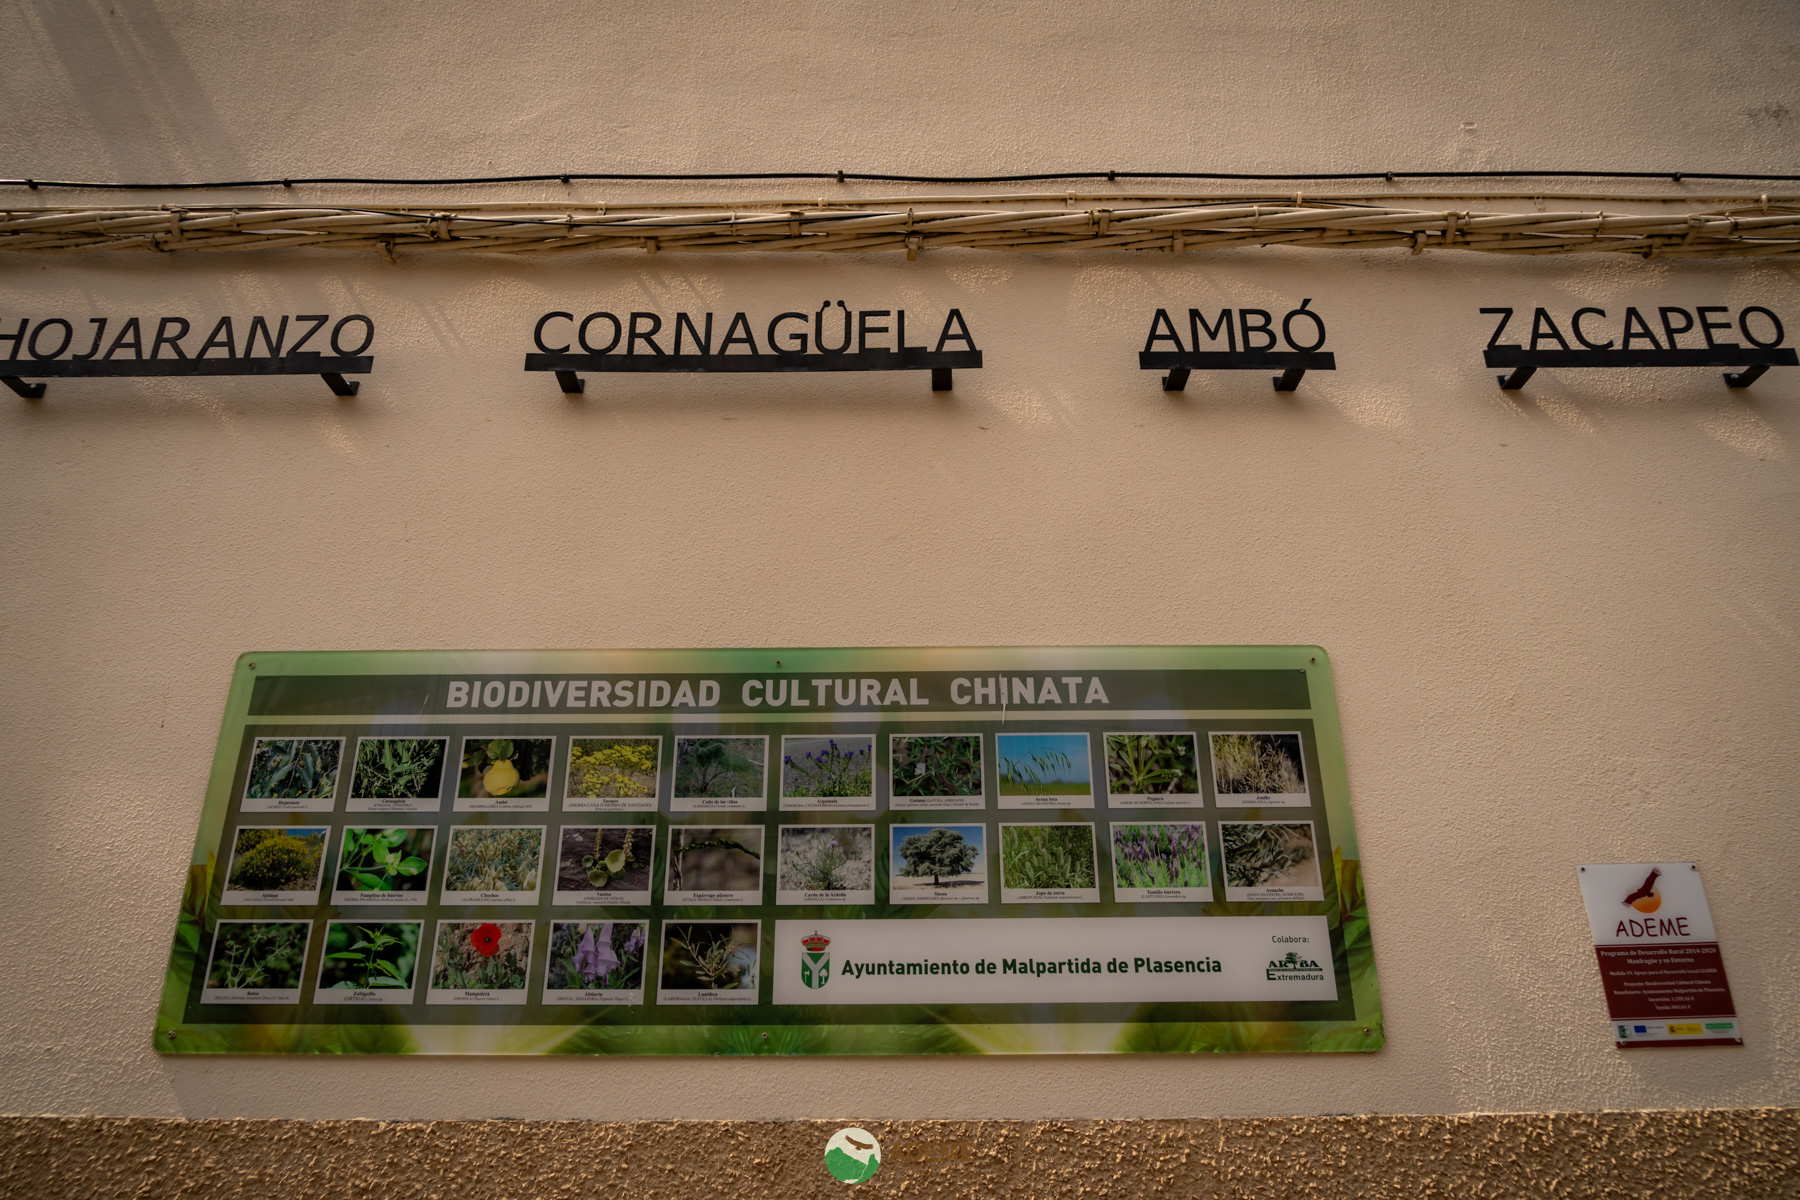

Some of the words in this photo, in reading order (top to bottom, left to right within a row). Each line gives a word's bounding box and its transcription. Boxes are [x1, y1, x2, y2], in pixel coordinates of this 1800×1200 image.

[533, 300, 977, 355] CORNAGÜELA
[1144, 299, 1326, 353] AMBÓ
[1480, 306, 1785, 350] ZACAPEO
[446, 680, 720, 708] BIODIVERSIDAD
[741, 678, 929, 706] CULTURAL
[950, 677, 1109, 705] CHINATA
[1616, 917, 1690, 938] ADEME
[841, 959, 970, 979] Ayuntamiento
[975, 959, 997, 975] de
[1002, 958, 1101, 978] Malpartida
[1107, 958, 1129, 974] de
[1134, 957, 1222, 973] Plasencia
[1266, 969, 1324, 981] Extremadura
